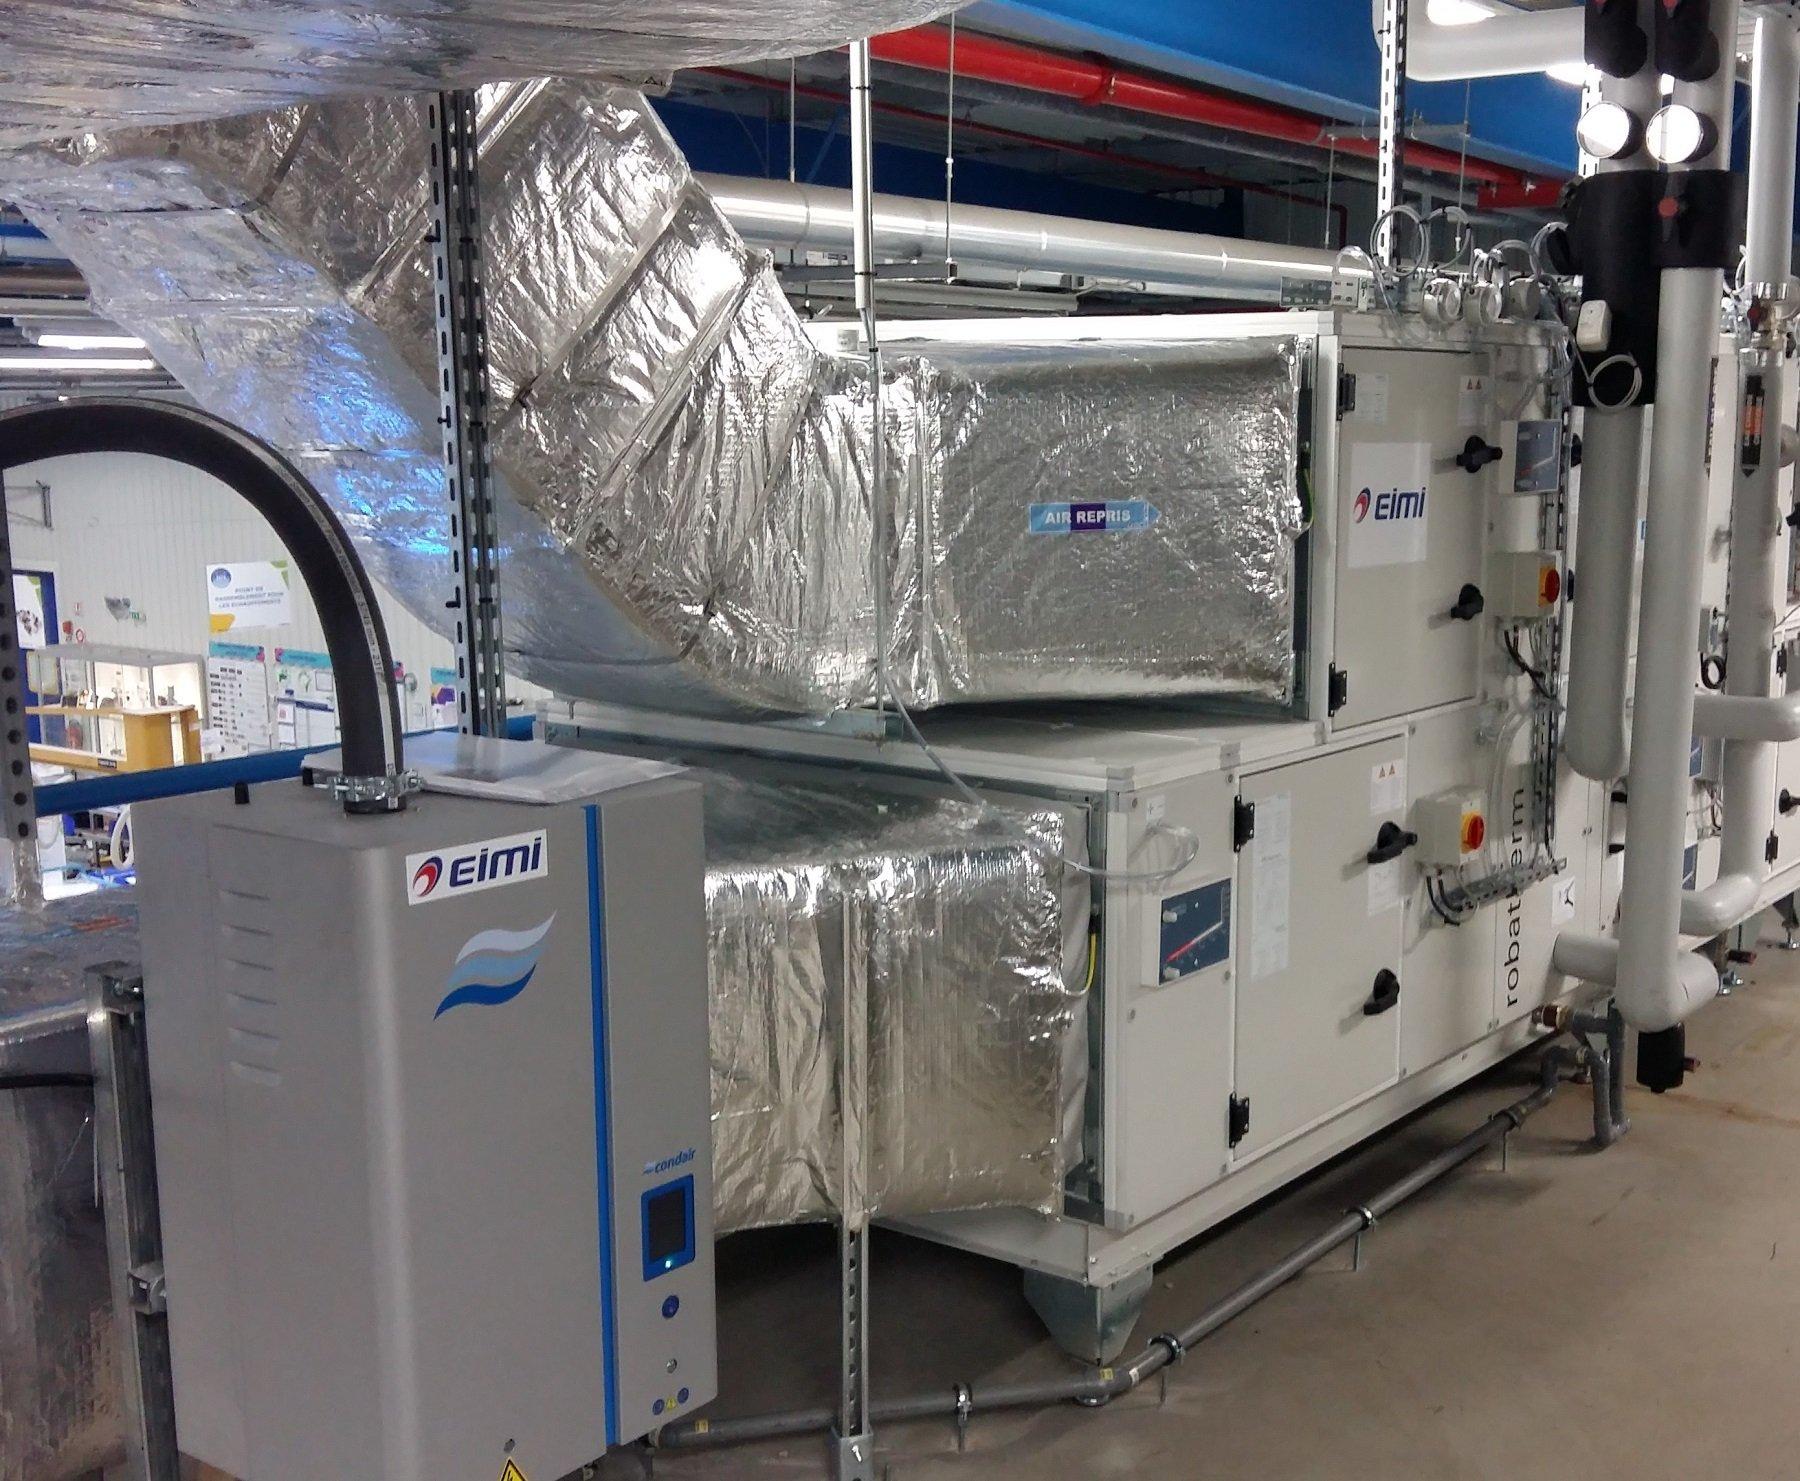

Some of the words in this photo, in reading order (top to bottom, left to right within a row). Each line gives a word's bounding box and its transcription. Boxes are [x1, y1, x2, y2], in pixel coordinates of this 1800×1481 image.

[1045, 511, 1071, 524] AIR
[1076, 510, 1131, 523] REPRIS
[655, 1147, 696, 1173] condair
